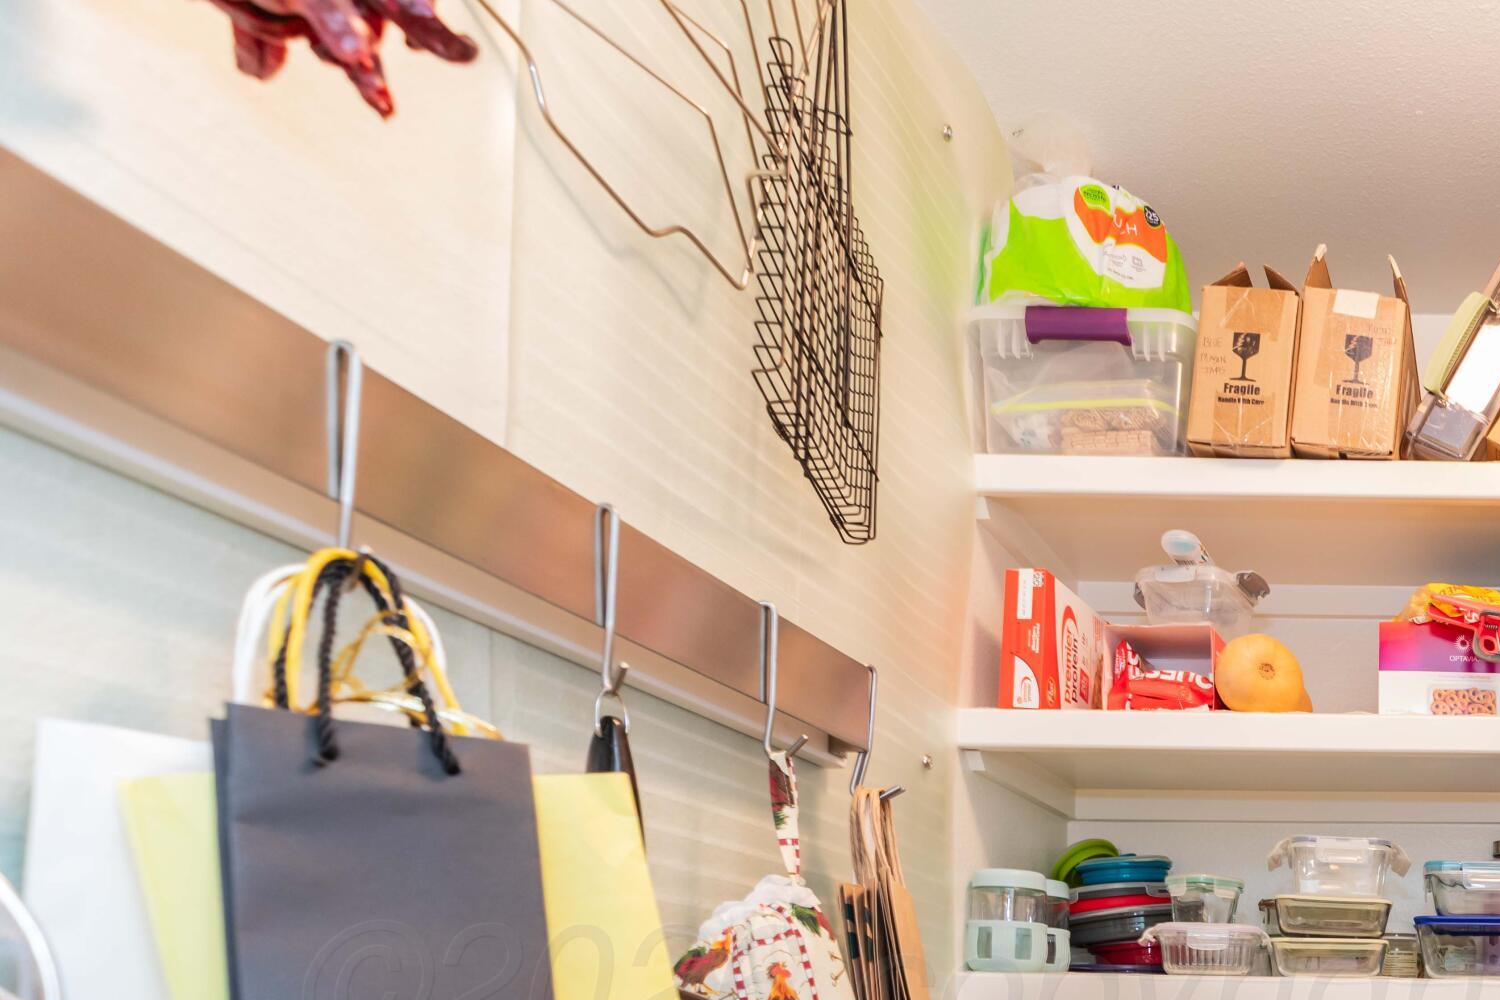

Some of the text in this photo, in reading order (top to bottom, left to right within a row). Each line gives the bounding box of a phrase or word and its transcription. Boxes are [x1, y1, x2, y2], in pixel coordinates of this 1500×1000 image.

[1223, 382, 1261, 396] Fragile
[1336, 384, 1374, 399] Fragile
[1064, 628, 1073, 704] premier
[1449, 655, 1480, 663] OPTAVIA
[1071, 637, 1079, 703] protein
